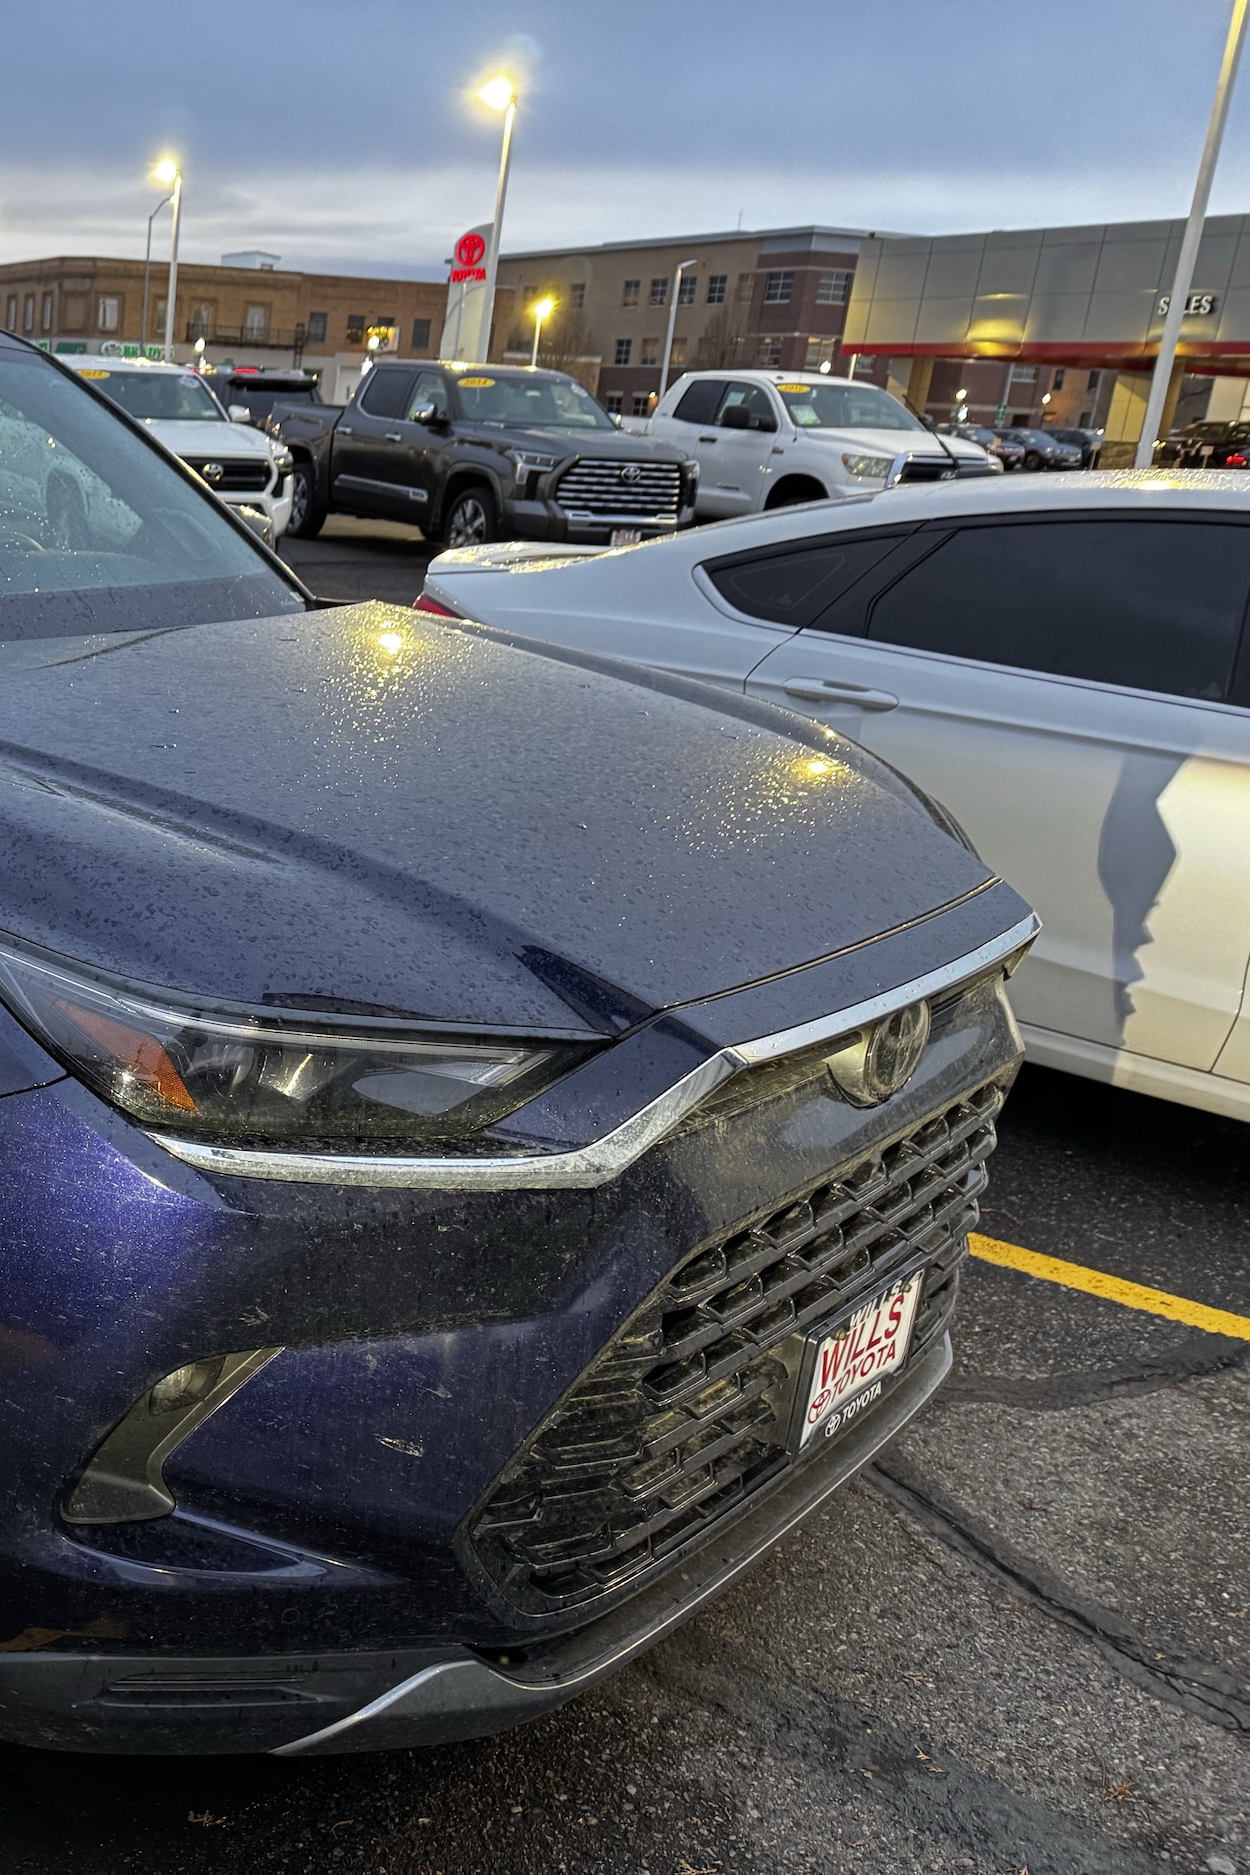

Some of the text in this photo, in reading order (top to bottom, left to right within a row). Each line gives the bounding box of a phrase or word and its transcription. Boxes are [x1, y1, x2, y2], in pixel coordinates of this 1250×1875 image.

[1158, 295, 1213, 315] SES
[821, 1295, 904, 1389] WILLS
[833, 1340, 896, 1402] TOYOTA
[841, 1381, 882, 1419] TOYOTA
